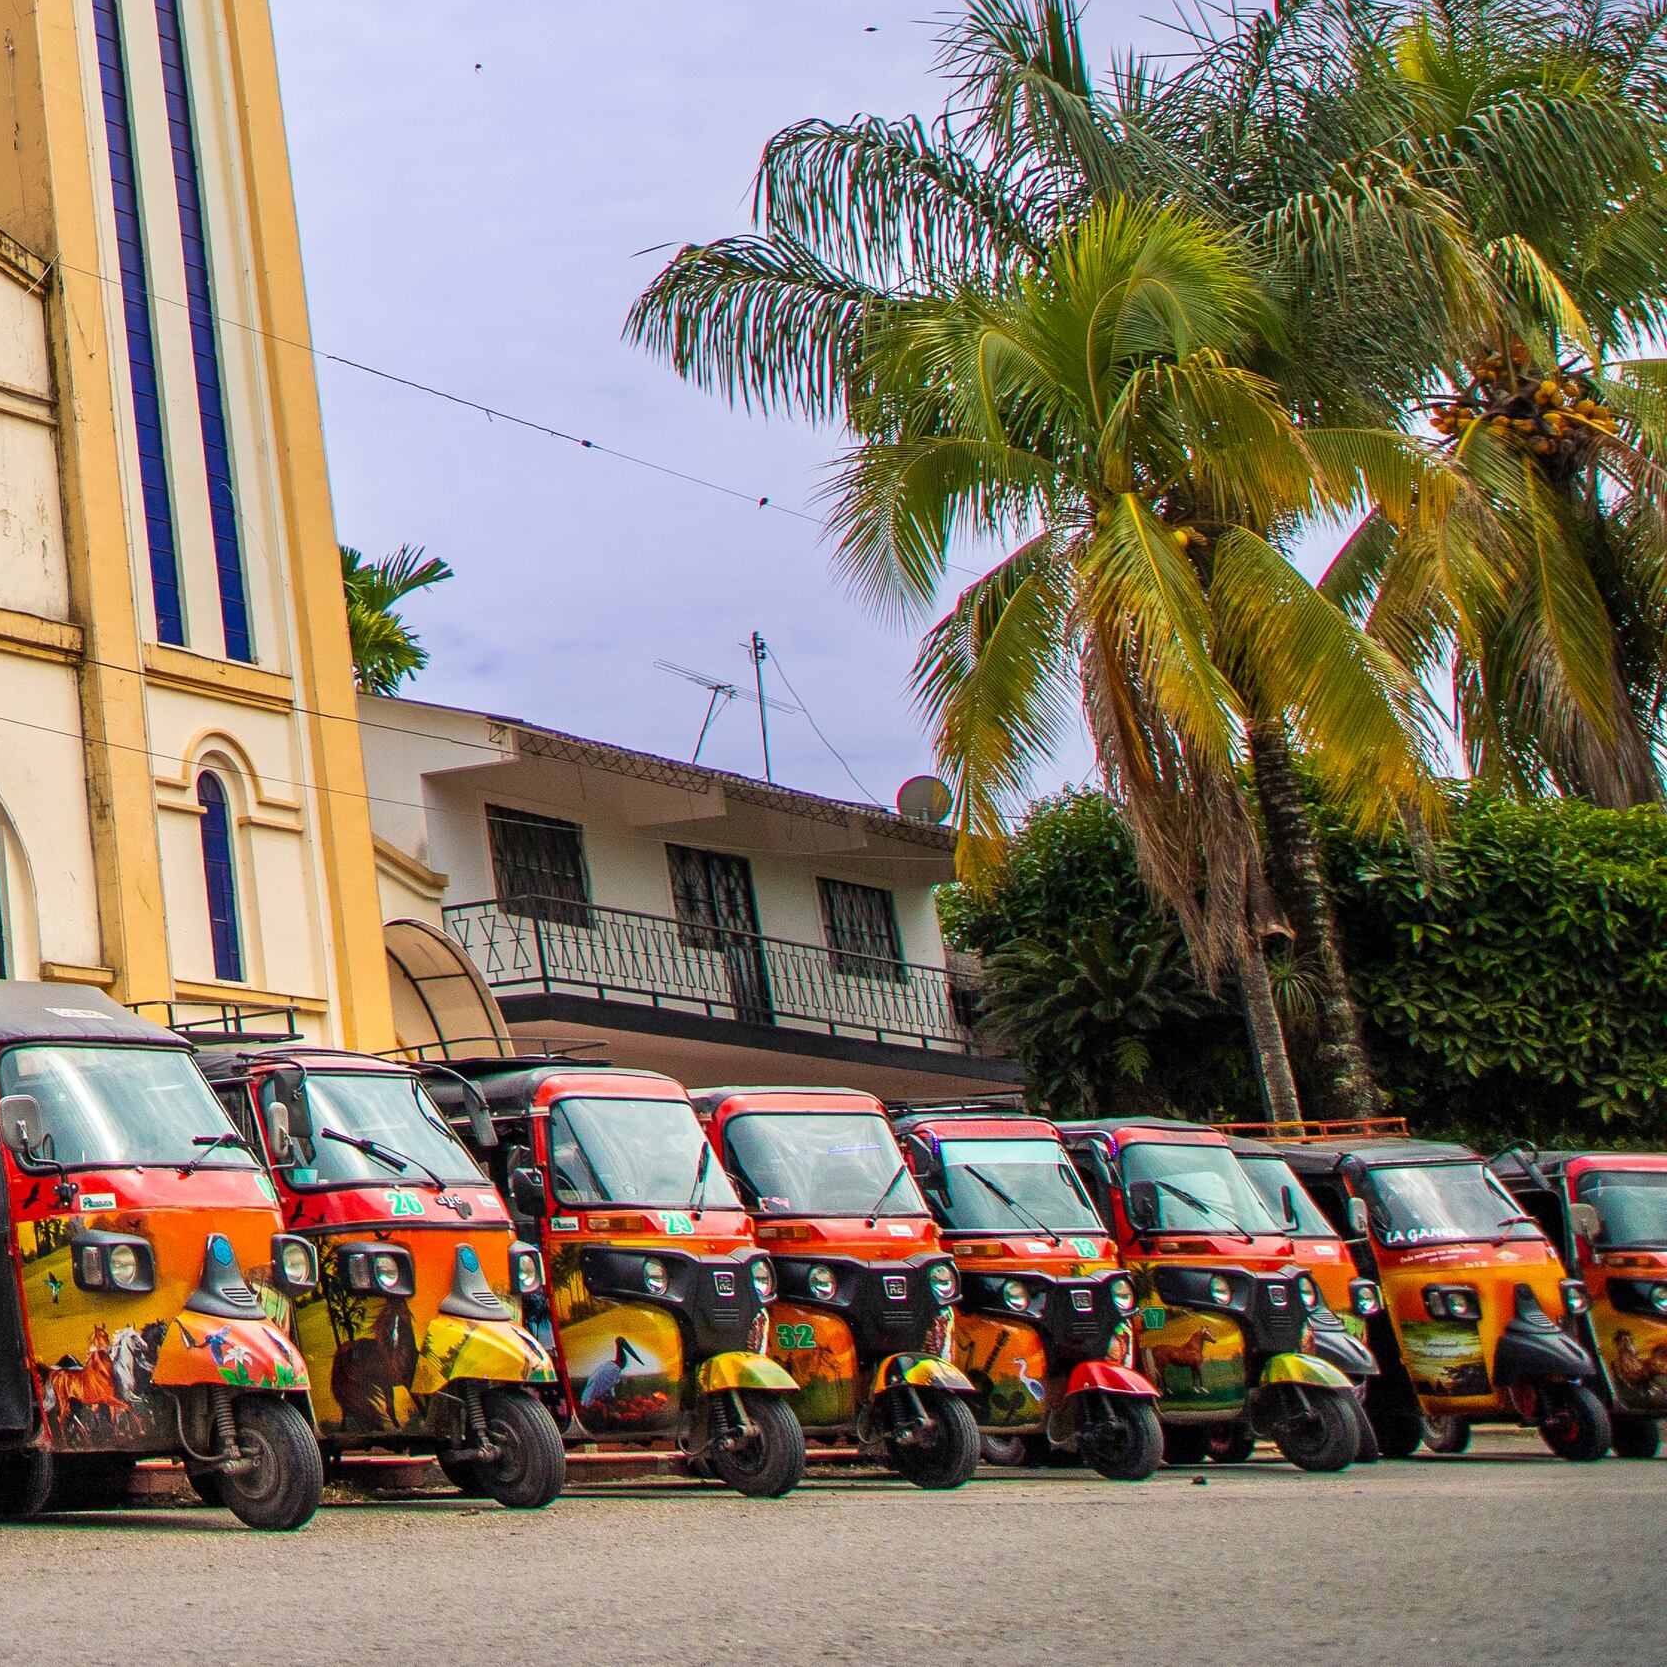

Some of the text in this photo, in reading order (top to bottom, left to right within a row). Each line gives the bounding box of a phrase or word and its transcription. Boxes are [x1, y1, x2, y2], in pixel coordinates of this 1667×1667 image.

[384, 1191, 426, 1216] 26
[658, 1211, 695, 1235] 29
[776, 1323, 816, 1349] 32
